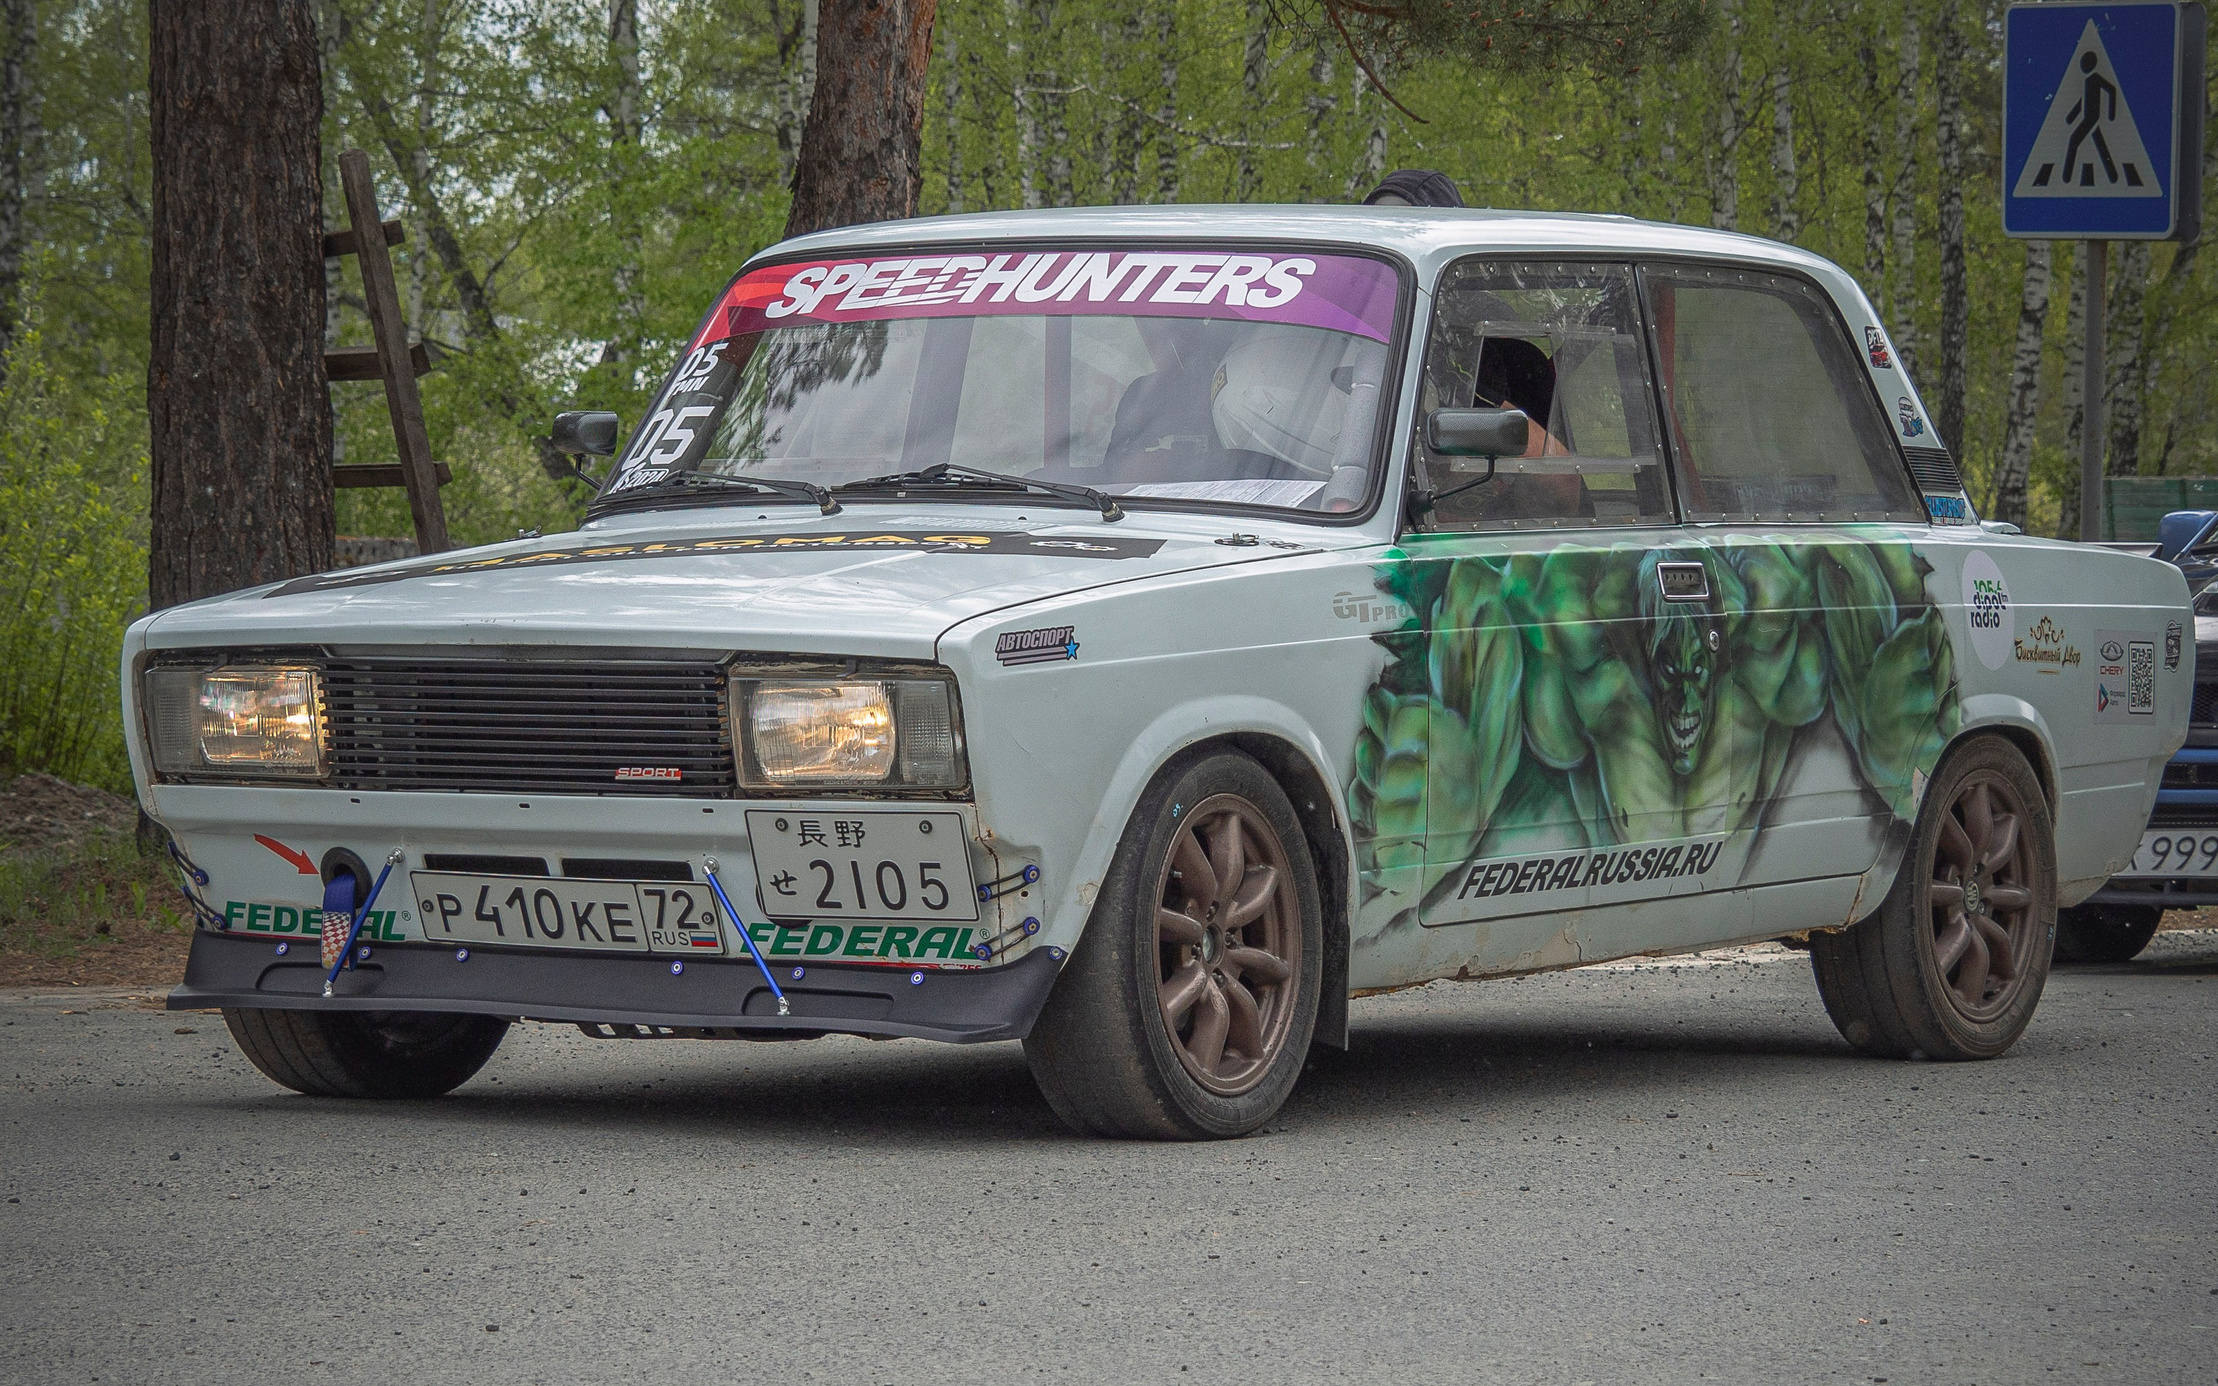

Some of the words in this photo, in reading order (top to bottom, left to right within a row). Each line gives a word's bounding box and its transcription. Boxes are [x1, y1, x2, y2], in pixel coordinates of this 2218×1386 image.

[766, 253, 1316, 318] SPEEDHUNTERS
[676, 343, 729, 381] 05
[621, 406, 715, 471] 05
[1970, 610, 2000, 628] radio
[996, 627, 1073, 652] АВТОСПОРТ
[2100, 666, 2124, 675] CHERY
[618, 767, 679, 778] SPORT
[798, 819, 865, 848] 長野
[770, 869, 798, 896] せ
[809, 859, 949, 911] 2105
[1457, 841, 1723, 899] FEDERALRUSSIA.RU
[225, 901, 406, 941] FEDEAL
[643, 888, 700, 929] 72
[652, 930, 690, 946] RUS
[740, 922, 982, 960] FEDERAL
